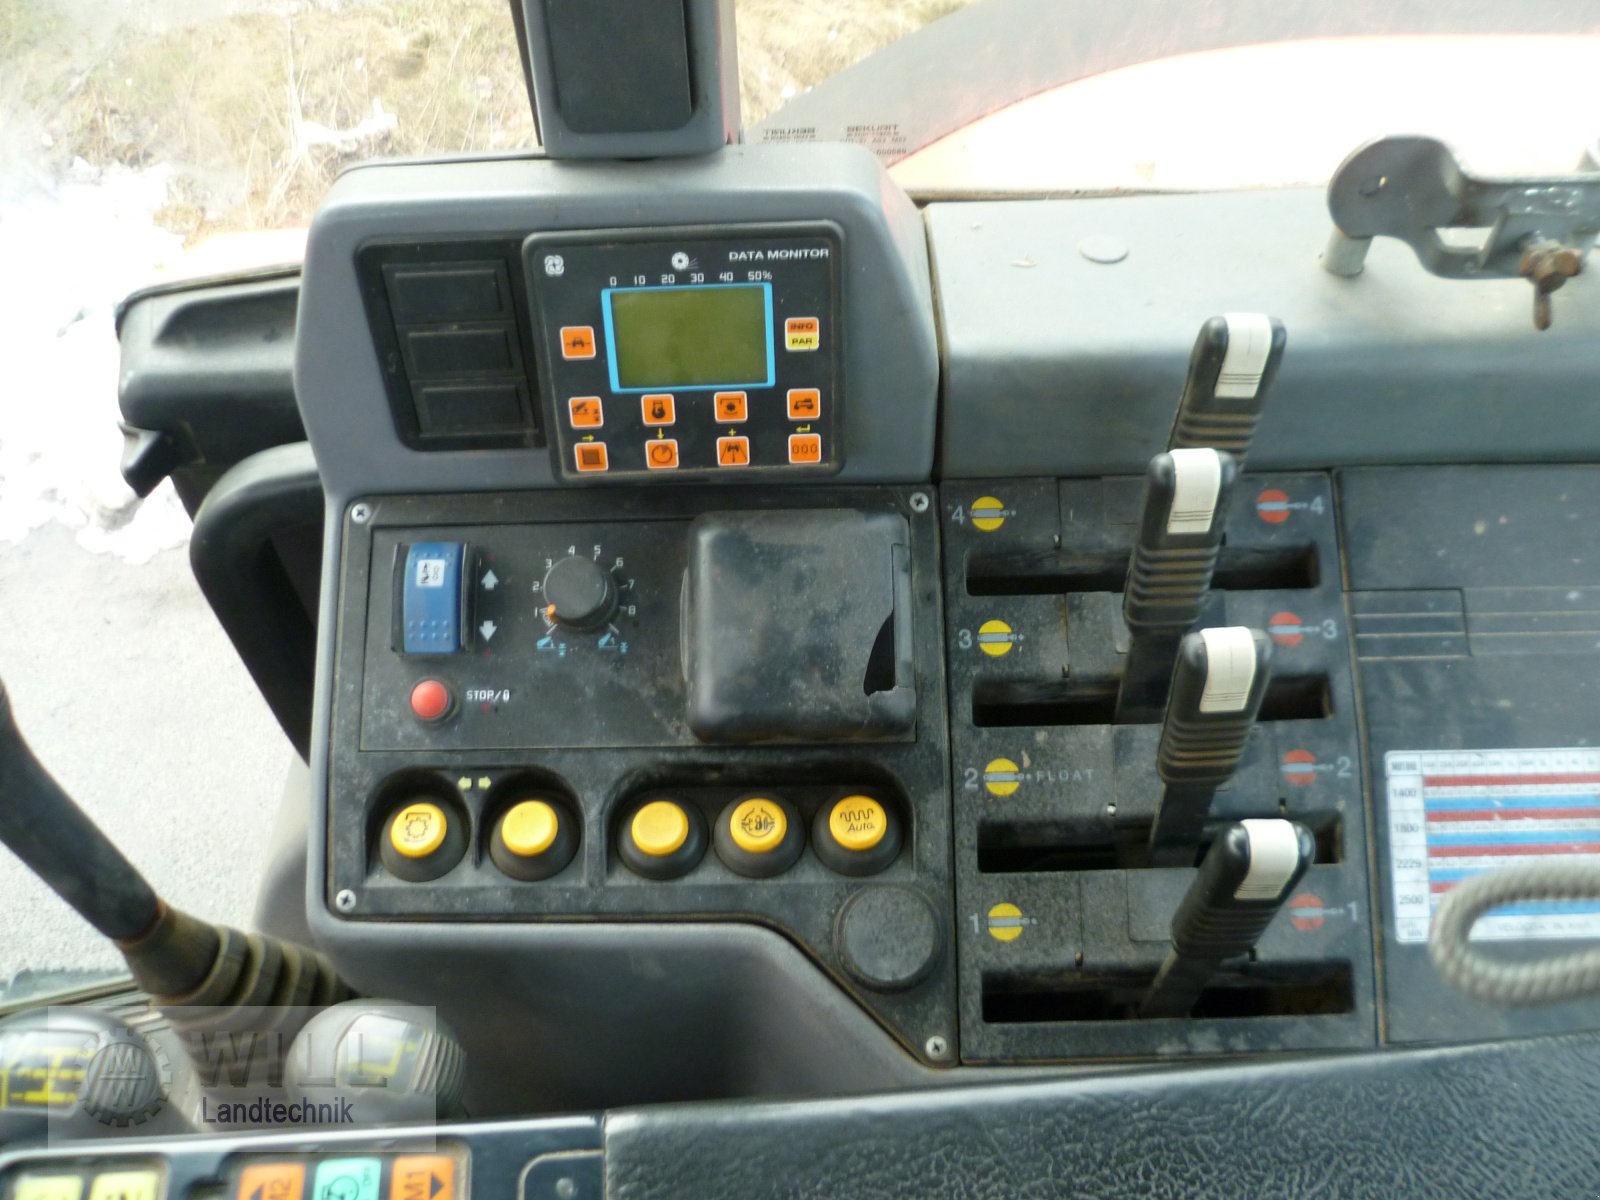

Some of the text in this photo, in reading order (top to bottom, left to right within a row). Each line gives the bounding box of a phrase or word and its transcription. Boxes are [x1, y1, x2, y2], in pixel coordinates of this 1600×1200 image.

[728, 248, 829, 262] DATA MONITOR
[634, 275, 646, 286] 10
[661, 273, 676, 285] 20
[690, 272, 705, 284] 30
[719, 271, 734, 283] 40
[748, 270, 772, 281] 50%
[789, 322, 814, 331] INFO
[791, 337, 813, 346] PAR
[1310, 496, 1325, 515] 4
[951, 505, 966, 524] 4
[568, 545, 576, 555] 4
[545, 558, 553, 569] 3
[616, 557, 624, 568] 6
[532, 581, 540, 591] 2
[628, 579, 635, 589] 7
[1323, 619, 1337, 640] 3
[958, 629, 973, 649] 3
[1337, 758, 1352, 777] 2
[964, 768, 1094, 790] 2 FLOAT
[1347, 902, 1358, 921] 1
[969, 914, 980, 934] 1
